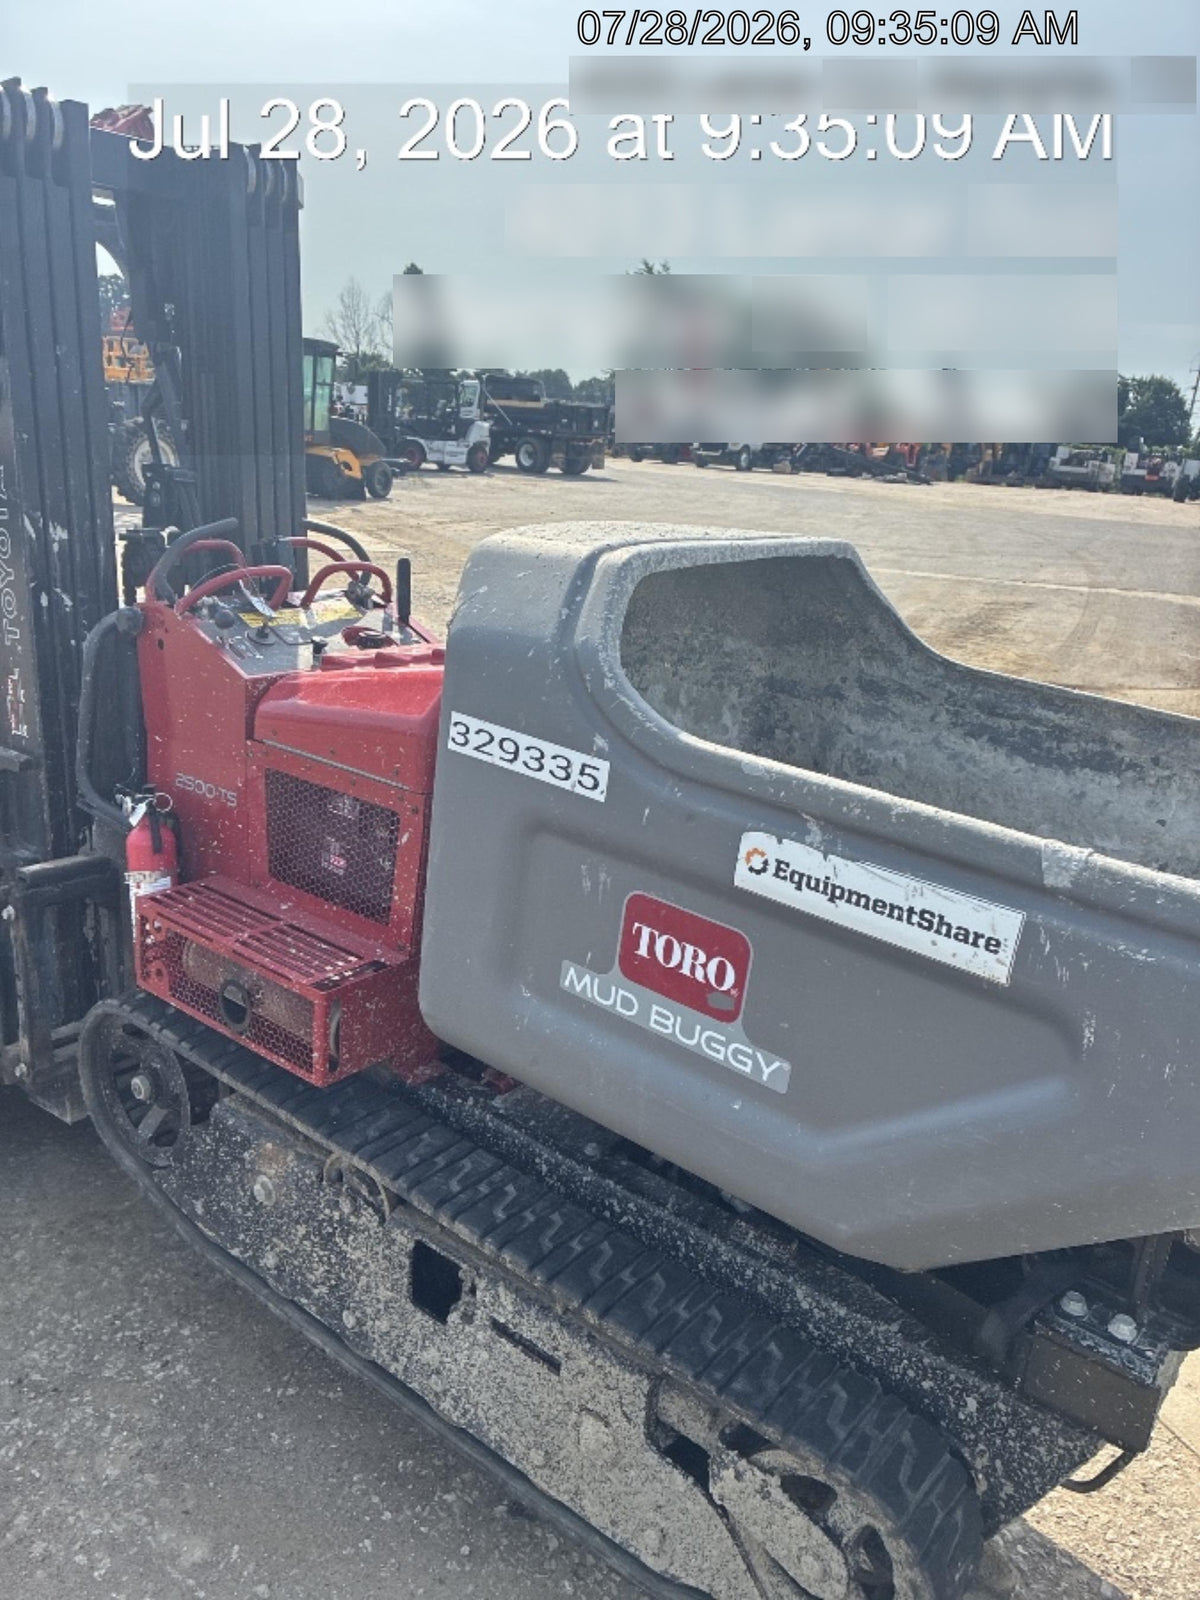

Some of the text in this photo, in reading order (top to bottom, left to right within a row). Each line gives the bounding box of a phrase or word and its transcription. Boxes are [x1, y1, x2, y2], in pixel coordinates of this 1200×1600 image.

[772, 858, 1002, 955] EquipmentShare
[632, 922, 736, 992] TORO
[564, 967, 782, 1081] MUD BUGGY
